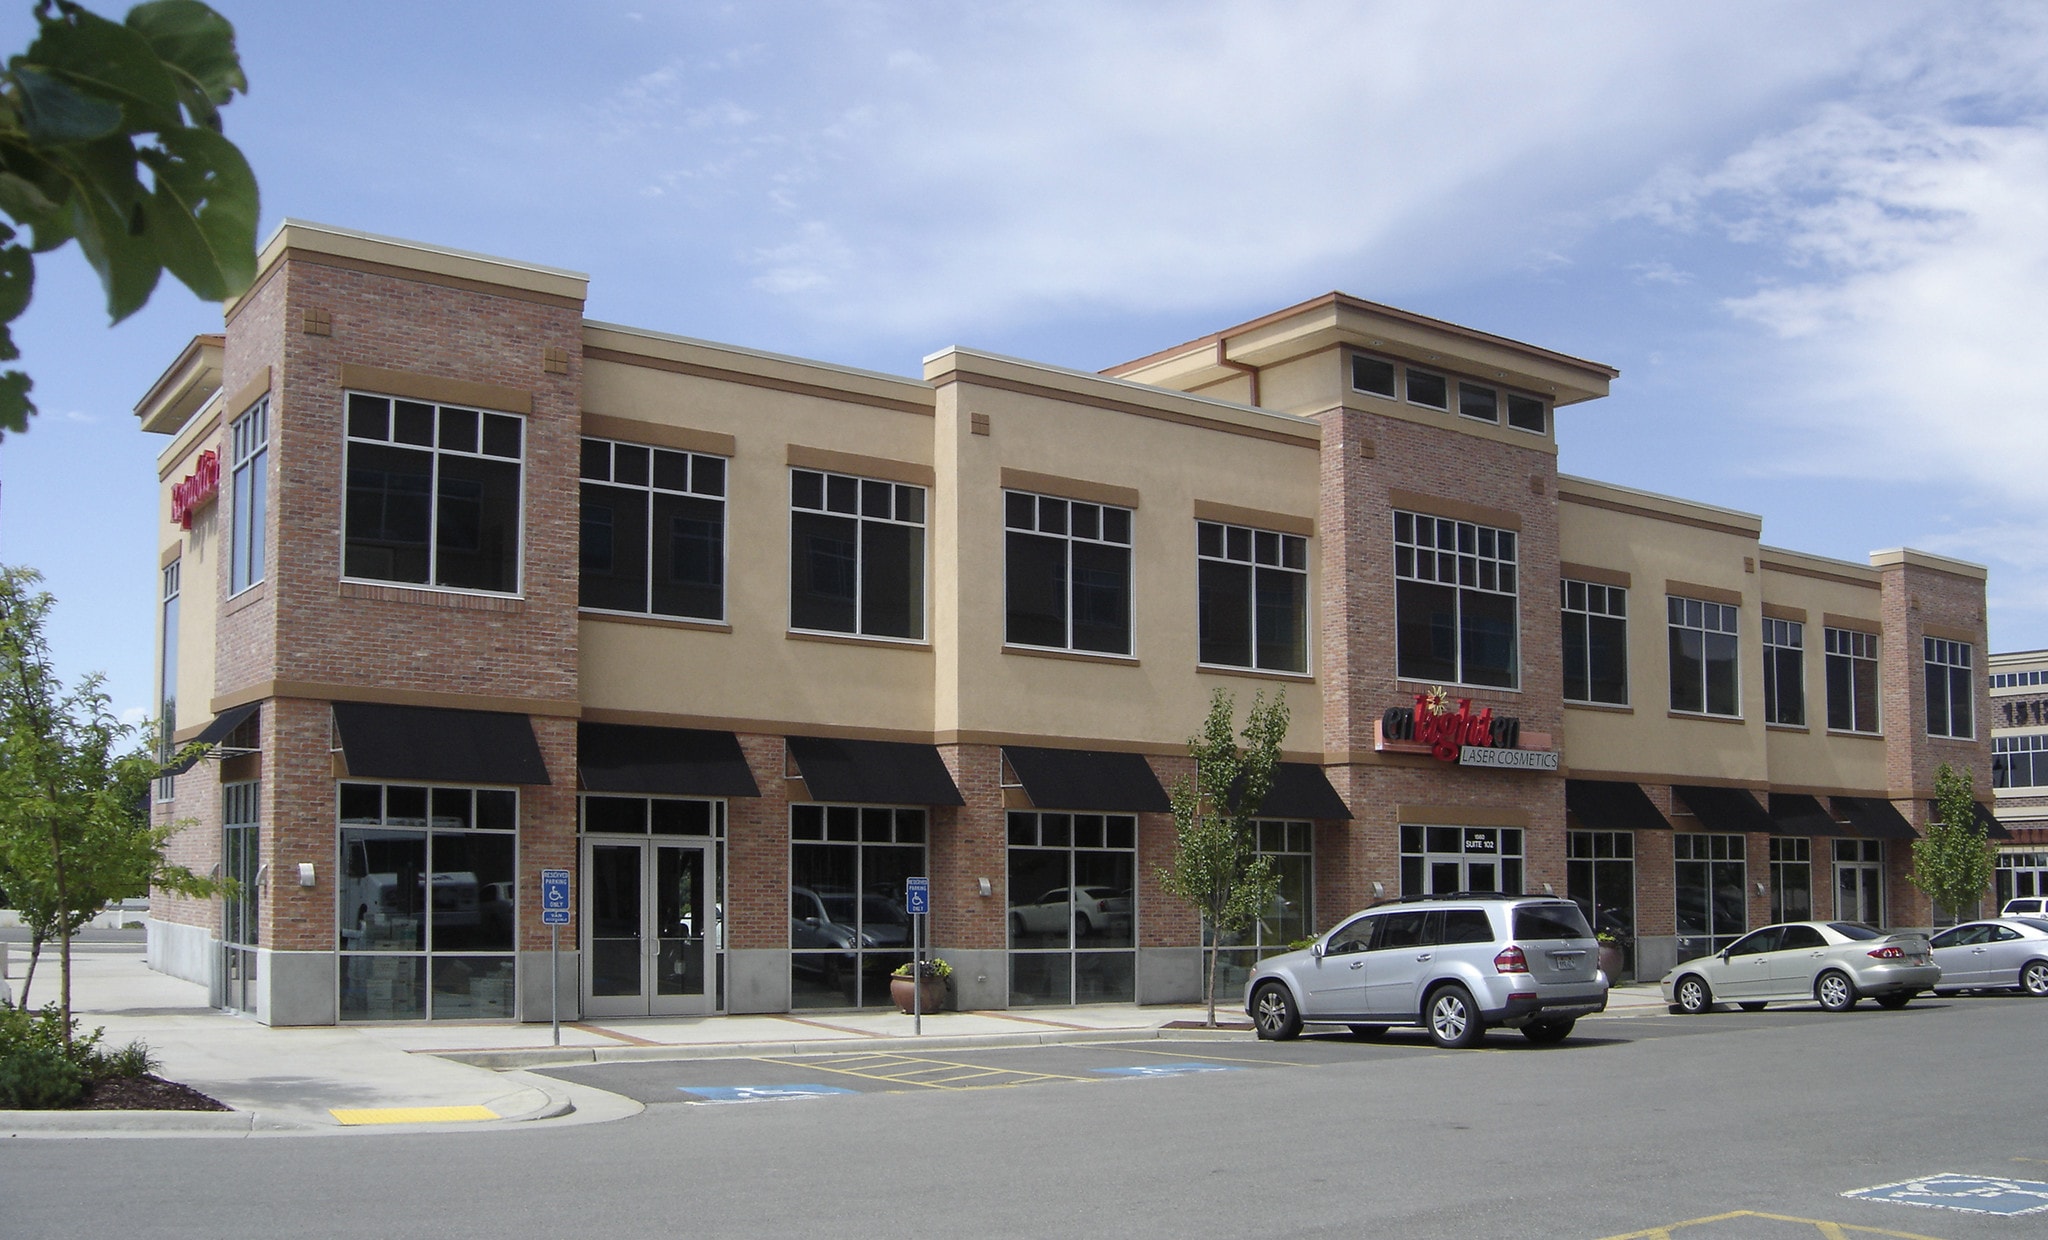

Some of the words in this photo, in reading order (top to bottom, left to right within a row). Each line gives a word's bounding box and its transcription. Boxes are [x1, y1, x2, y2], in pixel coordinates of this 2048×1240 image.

[1382, 692, 1520, 761] enlighten
[1462, 748, 1495, 764] LASER
[1497, 750, 1557, 768] COSMETICS
[1465, 840, 1483, 849] SUITE
[1483, 840, 1494, 849] 102
